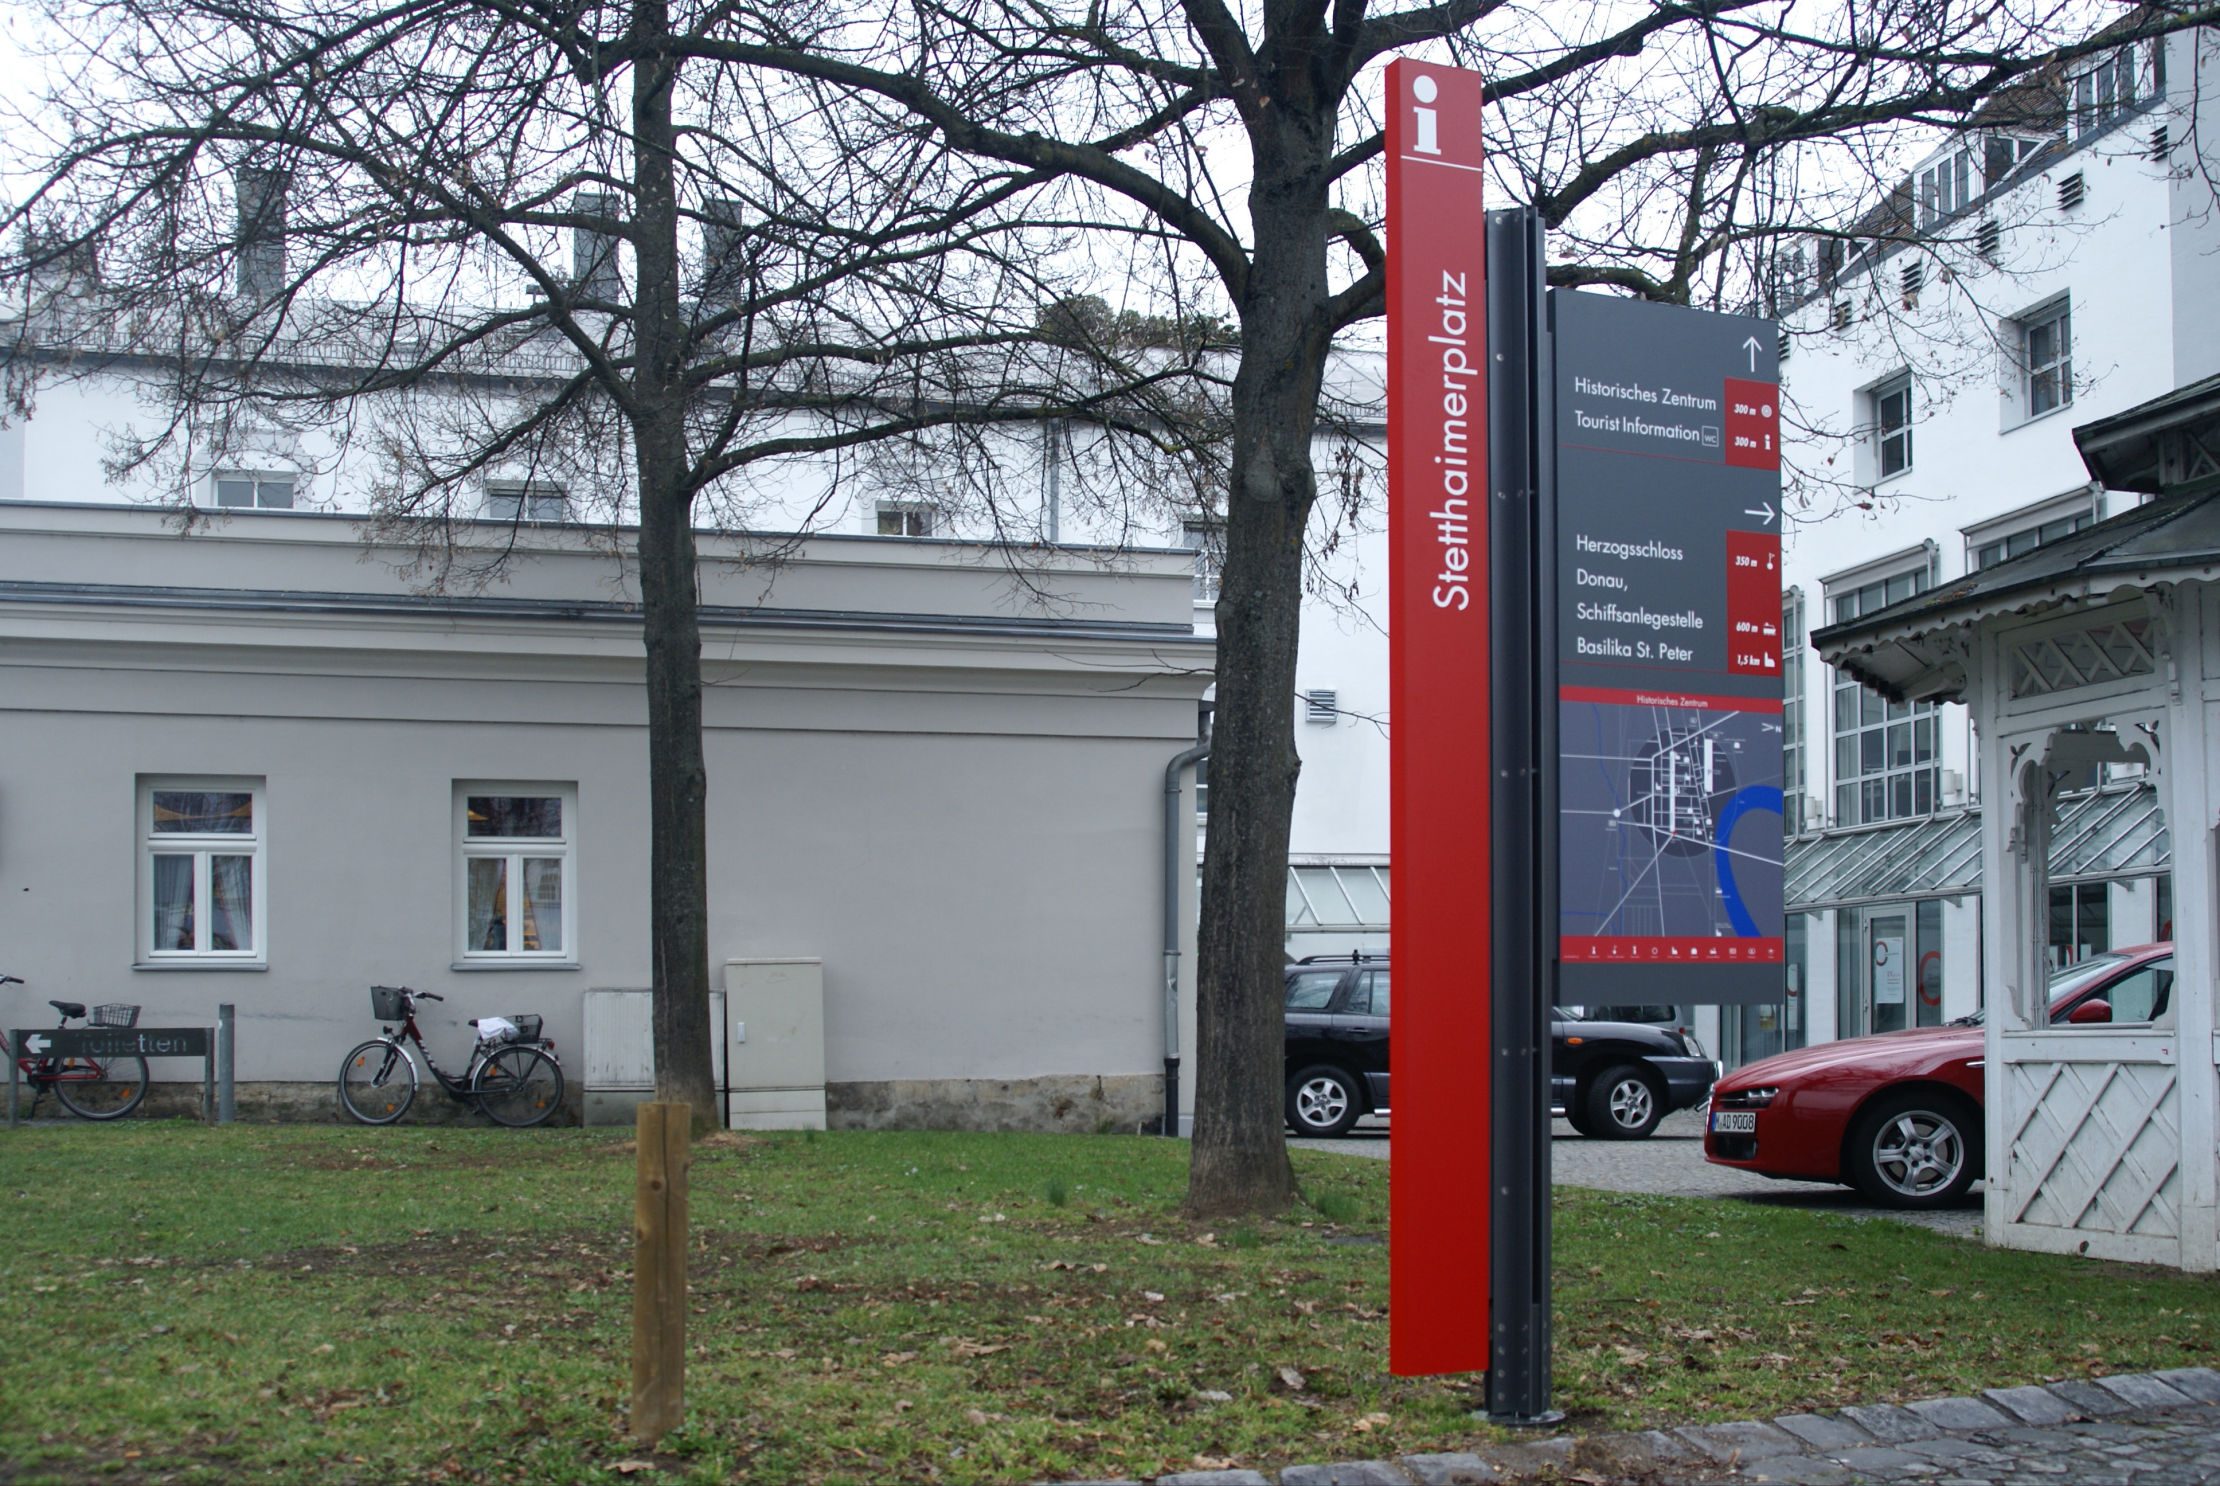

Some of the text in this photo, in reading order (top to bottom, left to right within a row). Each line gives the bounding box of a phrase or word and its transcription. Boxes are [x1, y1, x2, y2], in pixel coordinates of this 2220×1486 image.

[1575, 376, 1716, 411] Historisches Zentrum
[1734, 404, 1748, 415] 300
[1575, 410, 1620, 431] Tourist
[1623, 416, 1700, 442] Information
[1428, 270, 1478, 611] Stetthaimerplatz
[1734, 436, 1749, 447] 300
[1576, 534, 1683, 561] Herzogsschloss
[1735, 556, 1749, 567] 350
[1576, 568, 1628, 591] Donau,
[1577, 602, 1704, 630] Schiffsanlegestelle
[1736, 621, 1750, 632] 600
[1577, 636, 1693, 661] Basilika St. Peter
[1737, 654, 1760, 666] 1,5 km
[1636, 694, 1708, 708] Historisches Zentrum
